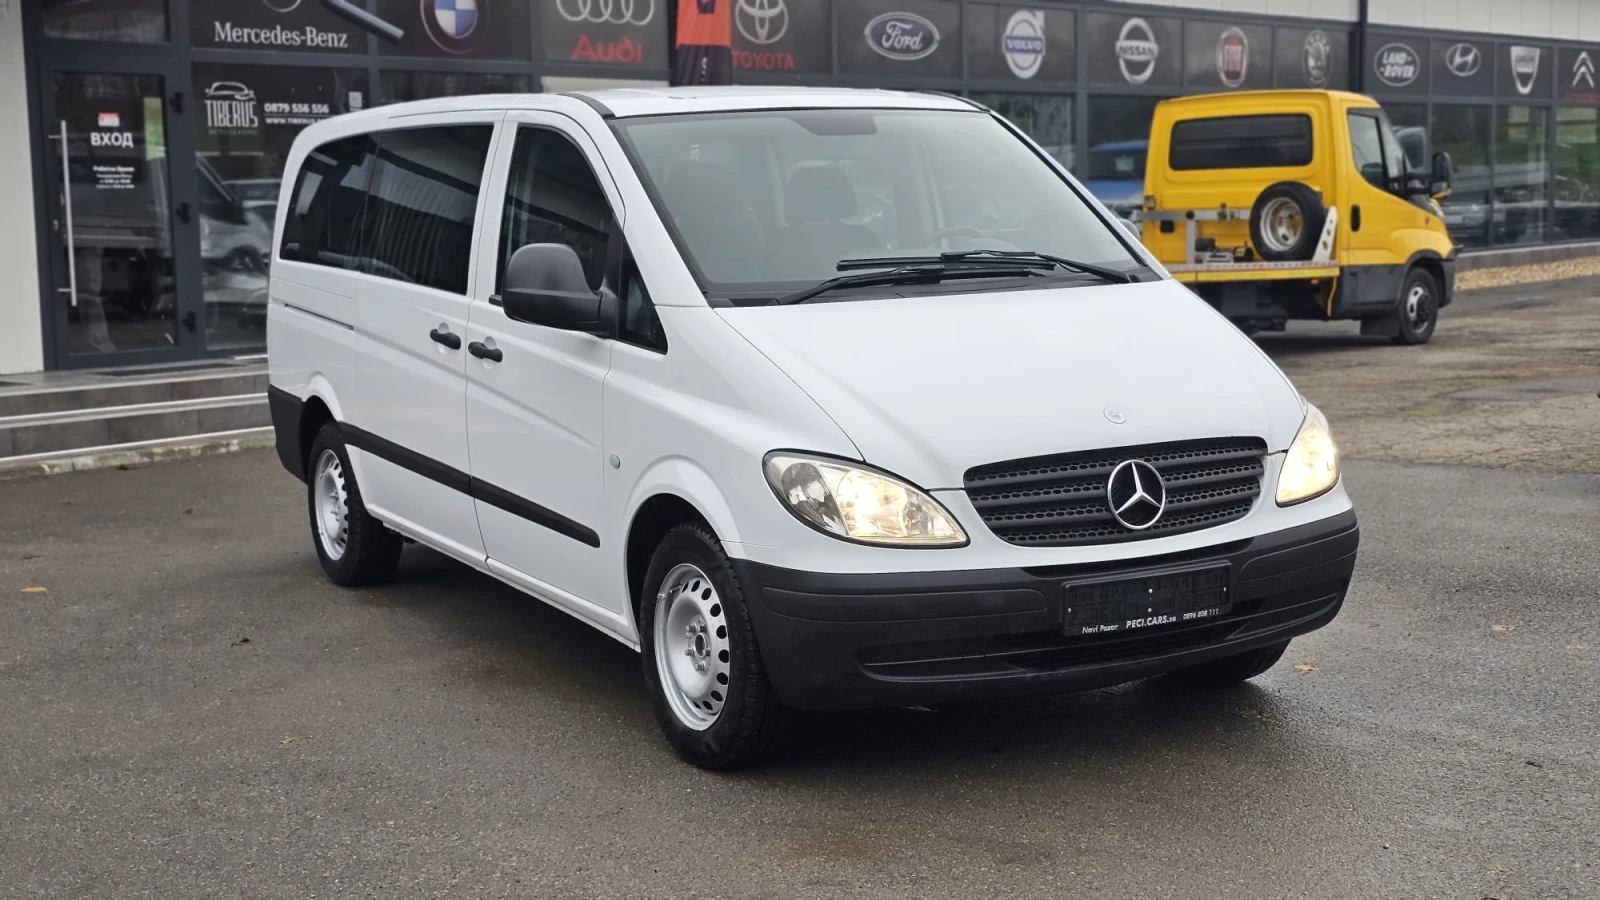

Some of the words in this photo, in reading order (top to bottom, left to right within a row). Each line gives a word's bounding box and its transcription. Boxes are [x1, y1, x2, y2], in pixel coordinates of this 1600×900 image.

[214, 20, 348, 48] Mercedes-Benz
[882, 21, 924, 50] Ford
[571, 33, 643, 63] Audi
[1006, 39, 1042, 51] VOLVO
[1119, 44, 1154, 57] NISSAN
[731, 50, 795, 71] TOYOTA
[205, 100, 259, 128] TIBERUS
[264, 102, 290, 113] 0879
[291, 103, 310, 114] 556
[311, 104, 329, 114] 556
[90, 131, 134, 148] ВХОД
